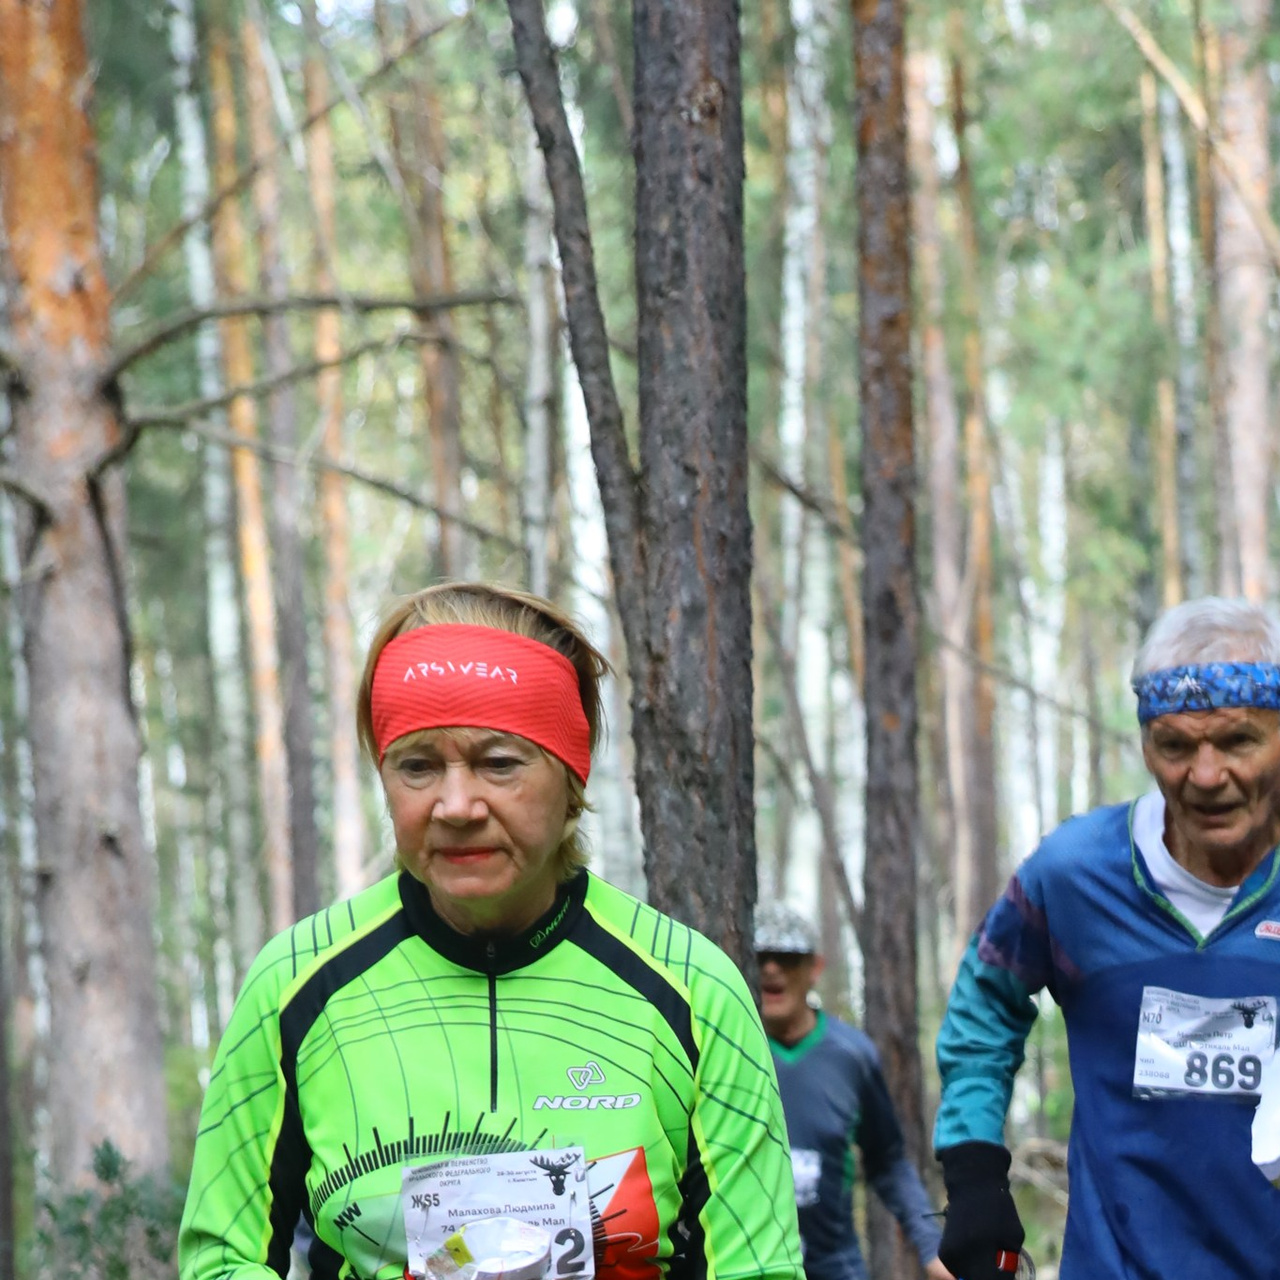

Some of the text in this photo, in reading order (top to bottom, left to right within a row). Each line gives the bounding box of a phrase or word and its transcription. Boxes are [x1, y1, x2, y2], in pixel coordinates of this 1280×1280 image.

[1184, 1051, 1262, 1090] 869
[533, 1093, 641, 1110] NORD
[445, 1166, 491, 1177] ФЕДЕРАЛЬНОГО
[448, 1203, 556, 1218] Малахова Людмила
[441, 1225, 456, 1233] 74
[552, 1228, 585, 1275] 2
